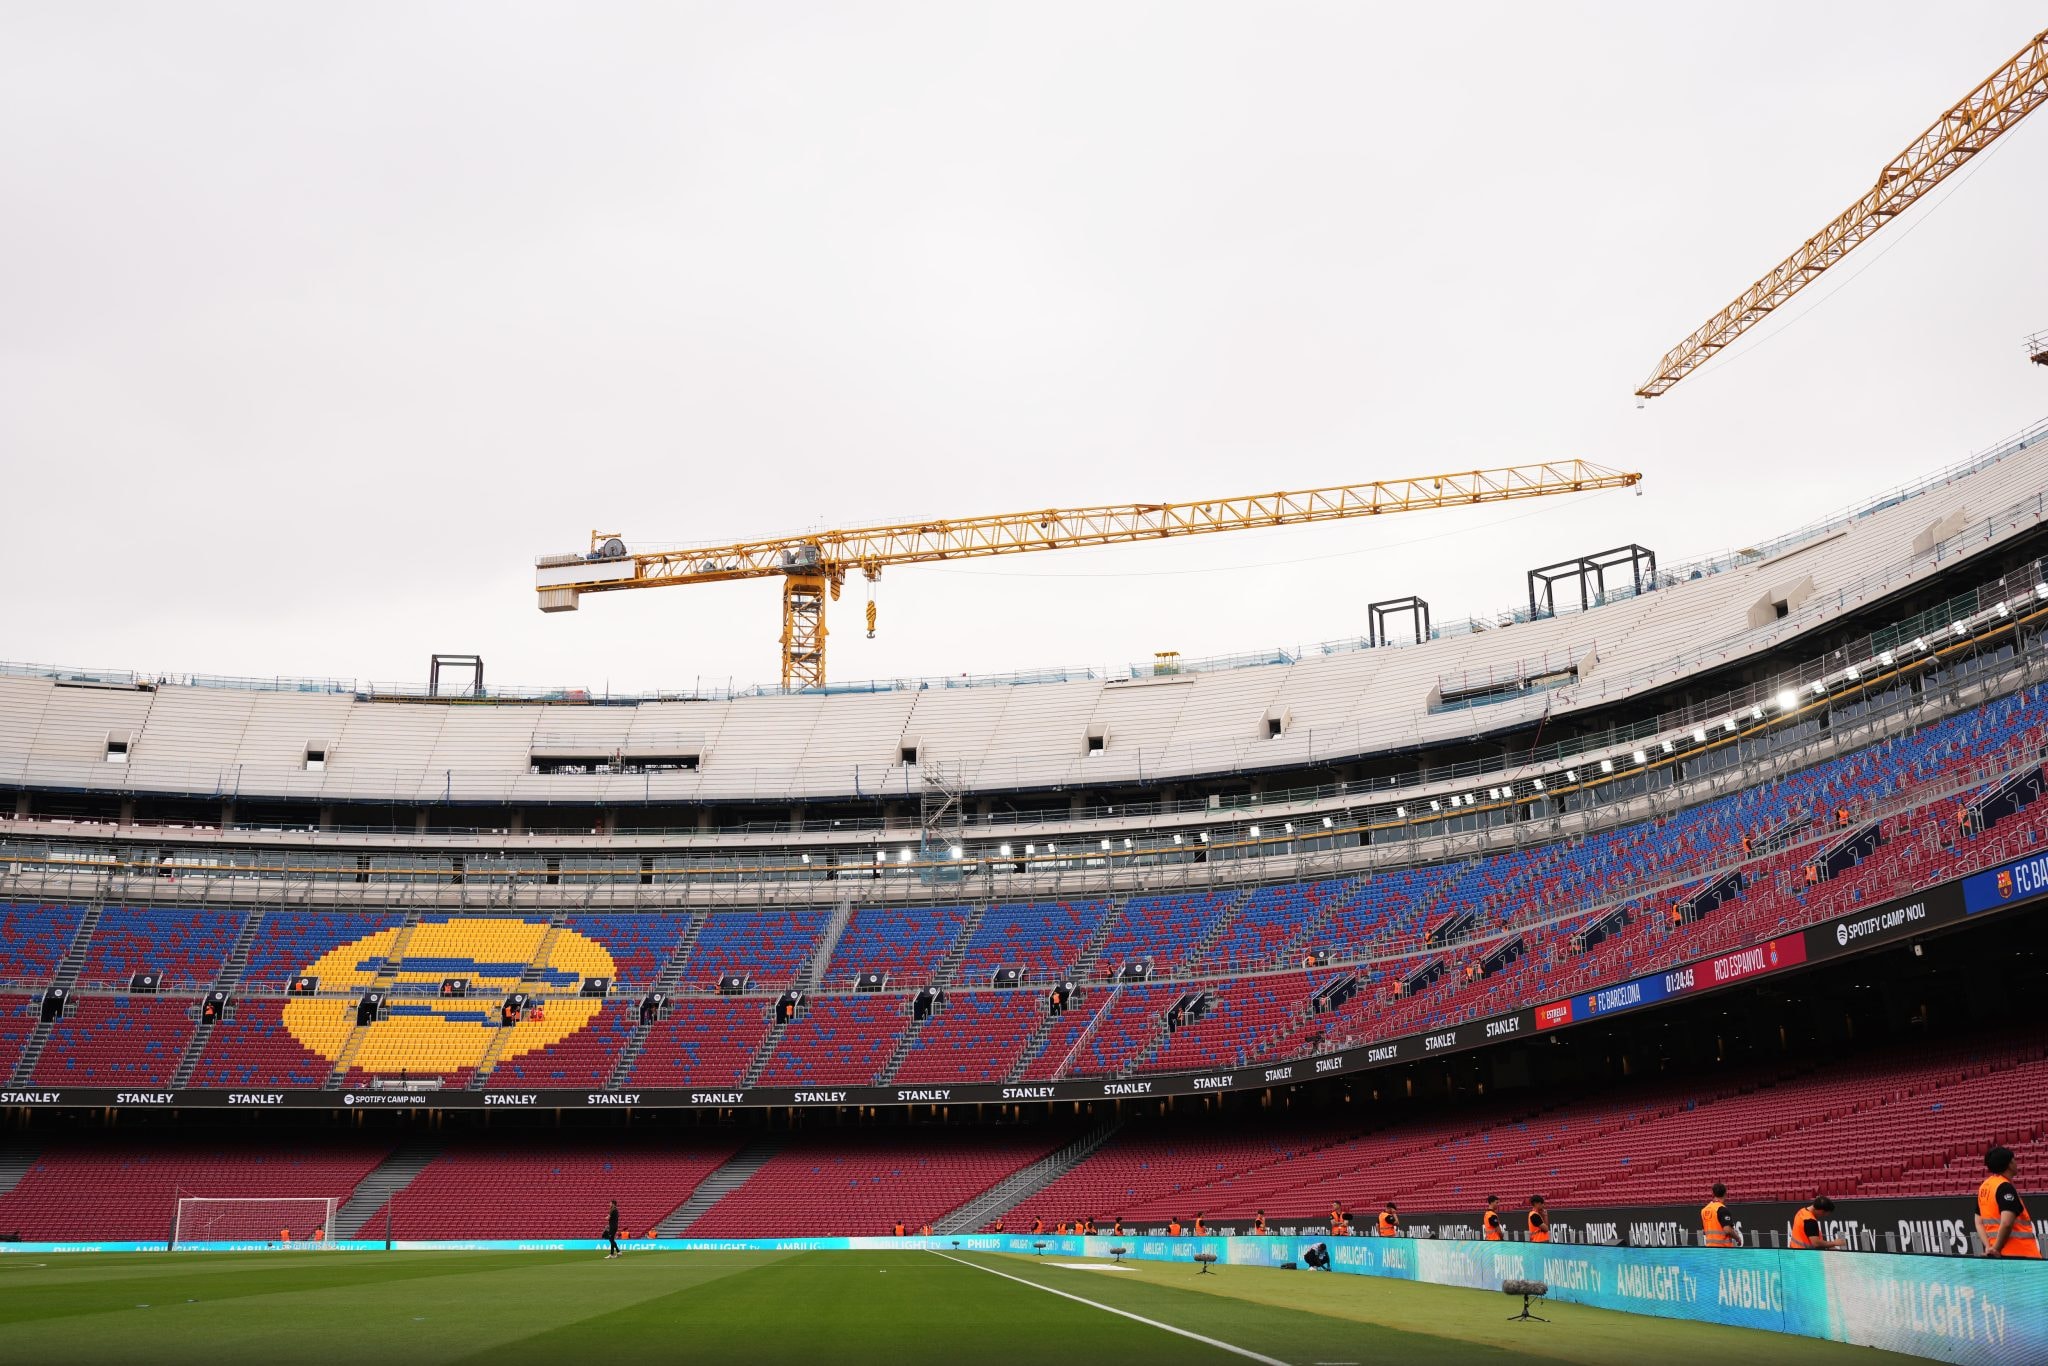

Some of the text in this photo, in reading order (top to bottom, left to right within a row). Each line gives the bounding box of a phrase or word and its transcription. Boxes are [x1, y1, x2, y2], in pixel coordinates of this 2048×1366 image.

[2015, 857, 2048, 894] FC BA
[1848, 902, 1926, 940] SPOTIFY CAMP NOU
[1714, 947, 1766, 981] RCD ESPANYOL
[1665, 968, 1695, 992] 01:24:43
[1598, 983, 1641, 1012] FC BARCELONA
[1486, 1016, 1520, 1037] STANLEY
[1425, 1032, 1456, 1050] STANLEY
[1368, 1045, 1397, 1063] STANLEY
[1316, 1057, 1343, 1073] STANLEY
[1265, 1067, 1293, 1082] STANLEY
[1104, 1083, 1152, 1095] STANLEY
[1194, 1076, 1233, 1089] STANLEY
[1, 1093, 60, 1103] STANLEY
[116, 1093, 174, 1103] STANLEY
[228, 1094, 283, 1104] STANLEY
[355, 1095, 426, 1104] SPOTIFY CAMP NOU
[484, 1094, 537, 1105] STANLEY
[588, 1094, 641, 1105] STANLEY
[691, 1093, 744, 1104] STANLEY
[794, 1092, 847, 1102] STANLEY
[897, 1090, 951, 1100] STANLEY
[1002, 1087, 1055, 1098] STANLEY
[967, 1239, 1001, 1249] PHILIPS
[1898, 1219, 1968, 1255] PHILIPS
[1335, 1245, 1367, 1267] AMBILIGHT
[1494, 1253, 1525, 1280] PHILIPS
[1543, 1256, 1588, 1291] AMBILIGHT
[1590, 1264, 1601, 1293] tv
[1617, 1263, 1680, 1302] AMBILIGHT
[1683, 1269, 1697, 1303] tv
[1980, 1292, 2004, 1346] tv
